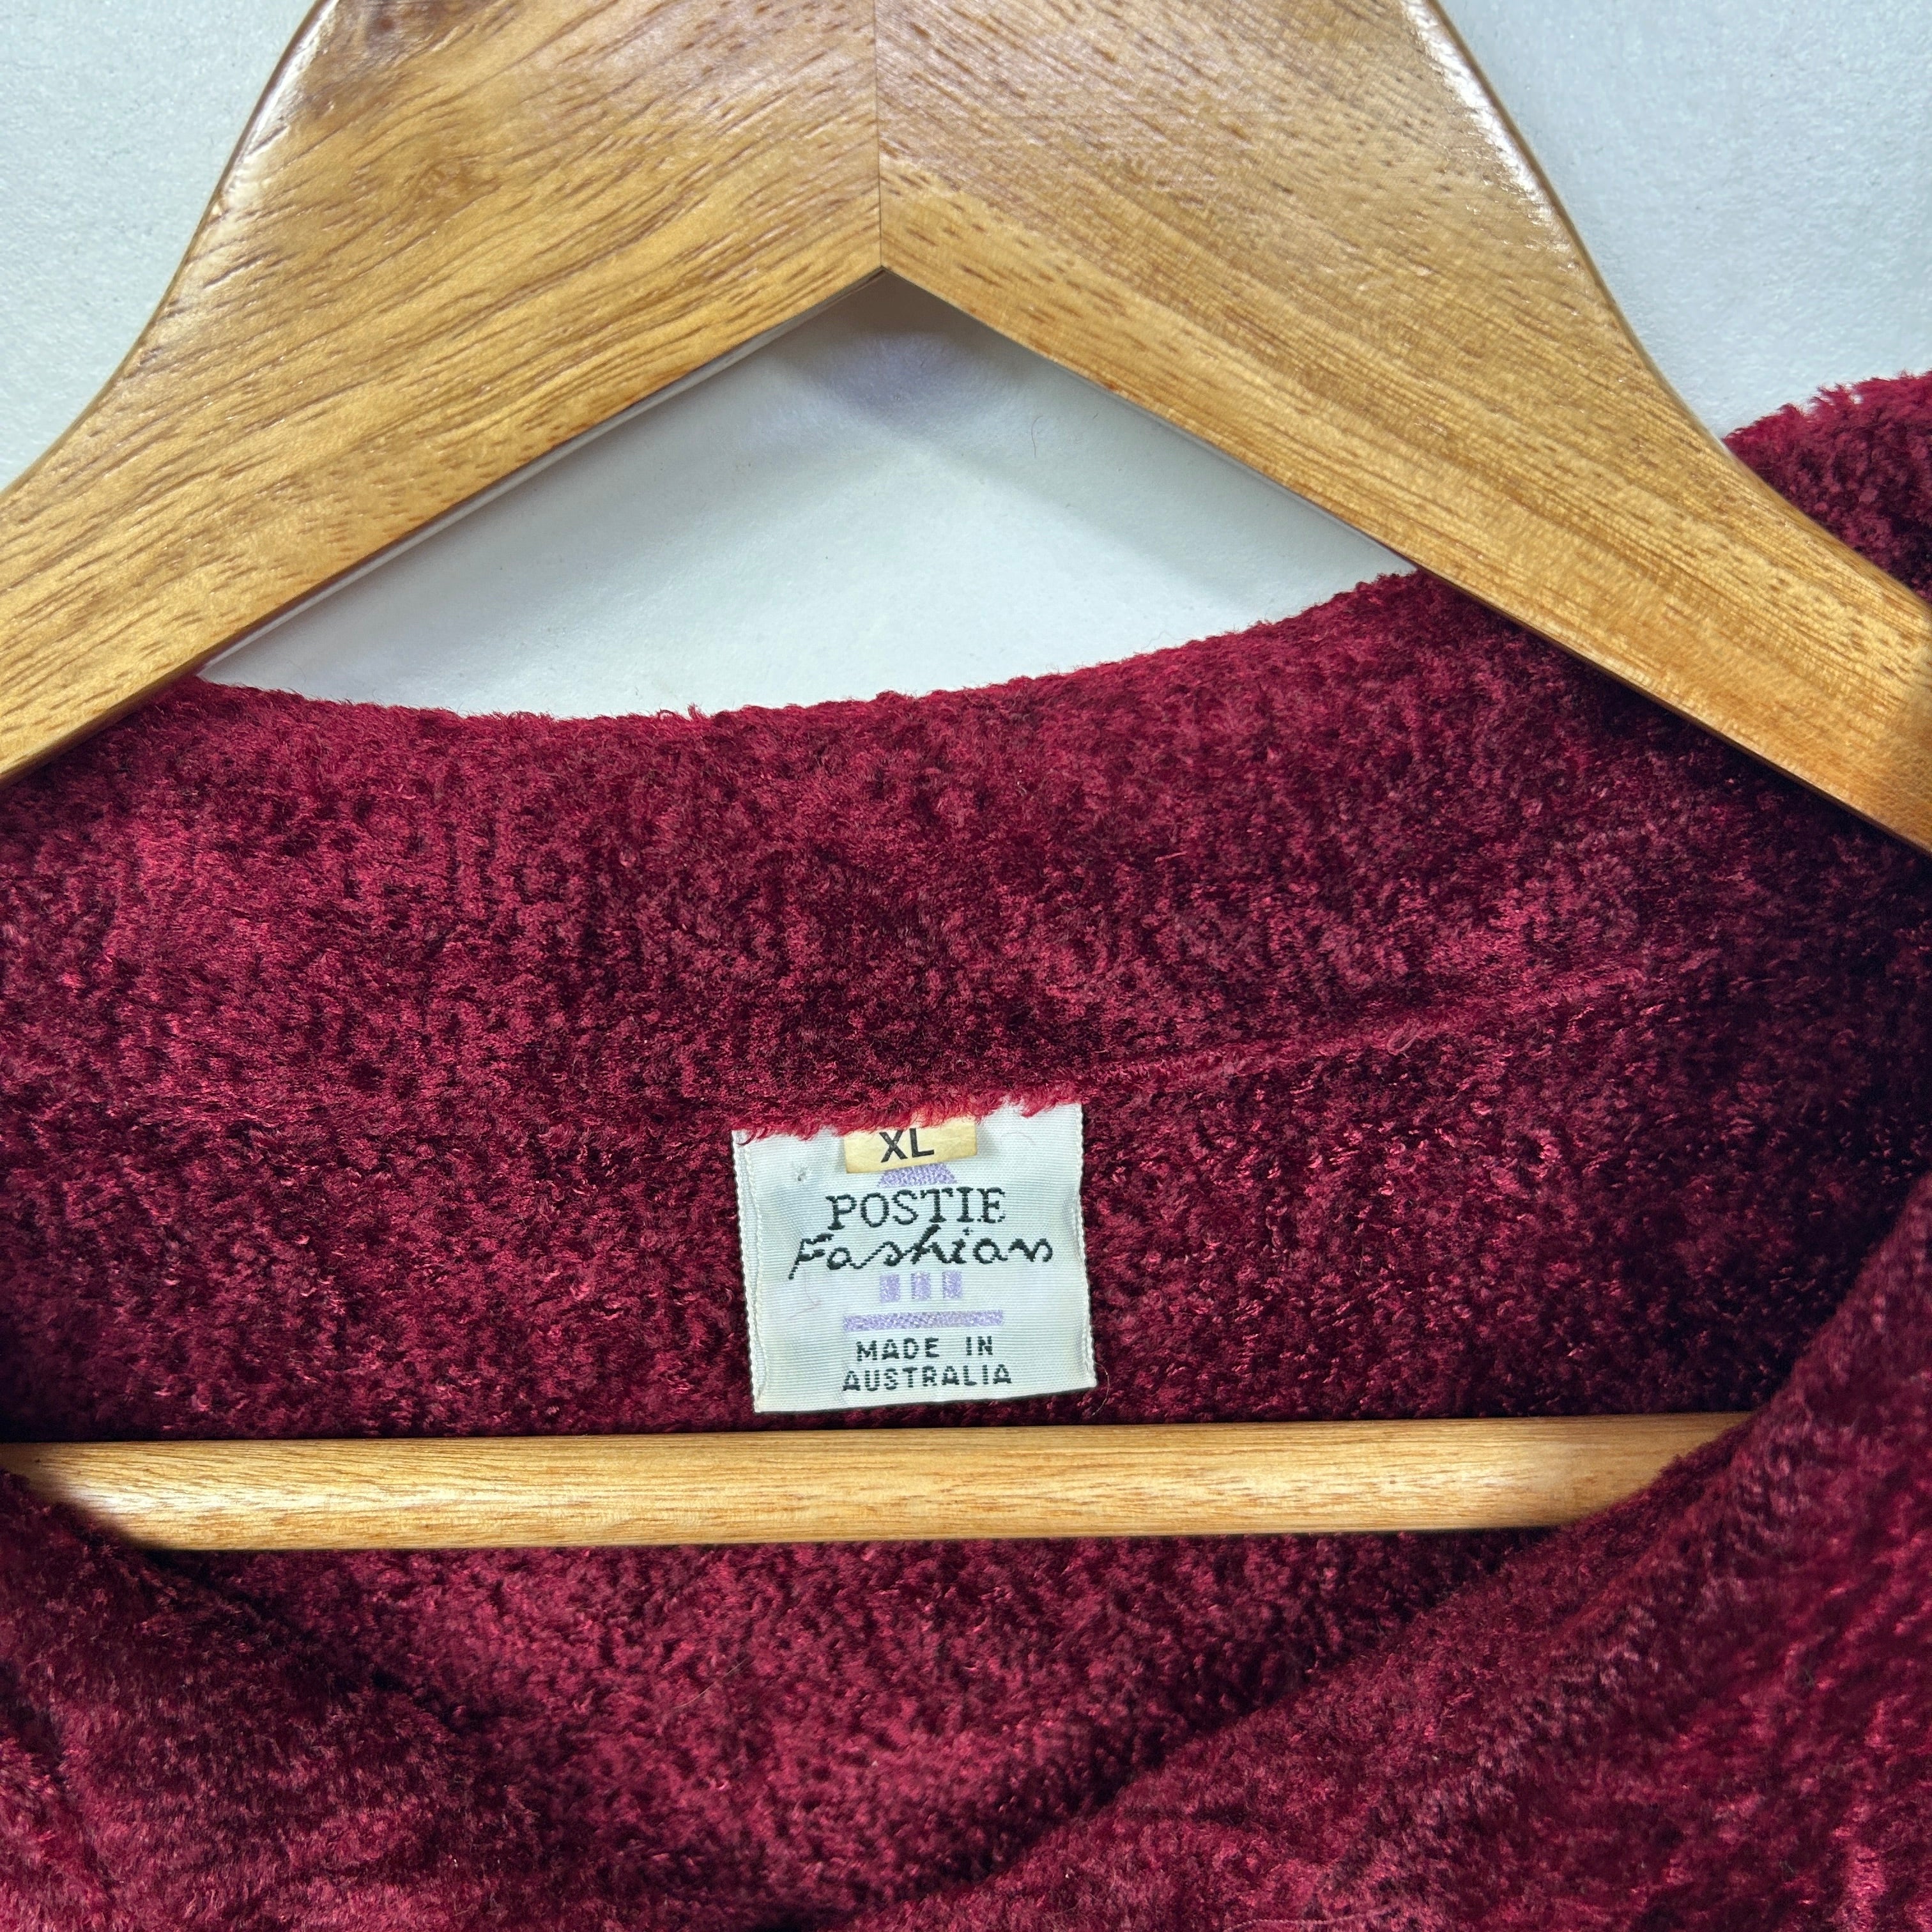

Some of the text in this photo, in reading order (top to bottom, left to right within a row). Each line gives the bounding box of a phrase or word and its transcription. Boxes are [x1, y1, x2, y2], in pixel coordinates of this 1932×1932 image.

[879, 1128, 935, 1163] XL
[826, 1187, 1006, 1230] POSTIE
[856, 1335, 993, 1361] MADE IN
[842, 1364, 1013, 1392] AUSTRALIA
